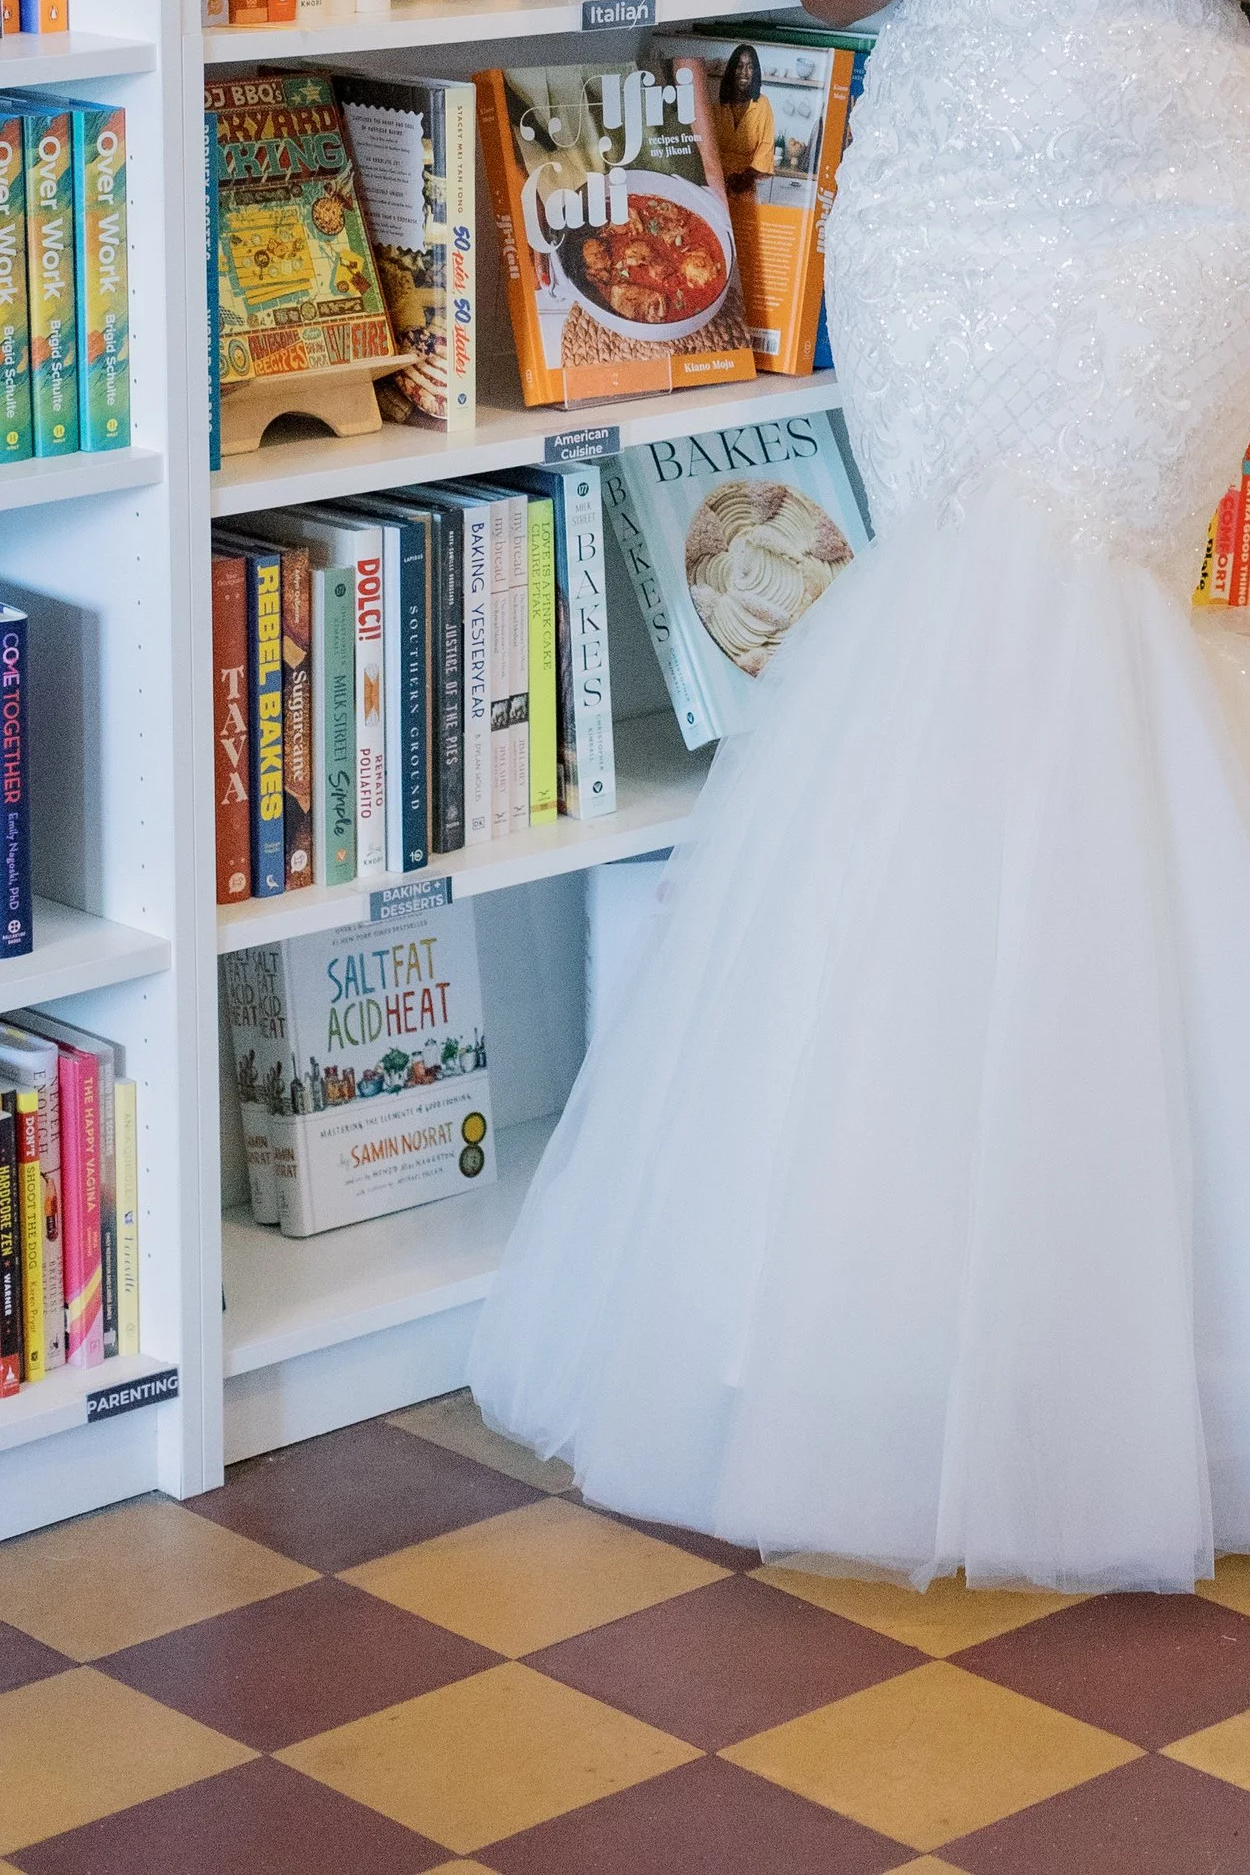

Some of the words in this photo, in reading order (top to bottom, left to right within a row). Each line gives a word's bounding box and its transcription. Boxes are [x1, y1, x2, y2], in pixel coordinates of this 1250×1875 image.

[590, 1, 649, 24] Italian
[648, 135, 680, 146] recipes
[681, 132, 703, 143] from
[650, 147, 664, 158] my
[665, 145, 692, 157] jikoni
[96, 131, 119, 206] Over
[98, 213, 121, 296] Work
[104, 313, 119, 353] Brigid
[106, 355, 119, 406] Schulte
[684, 361, 711, 374] Kiano
[711, 359, 735, 373] Moju
[553, 428, 609, 447] American
[560, 444, 603, 460] Cuisine
[646, 416, 820, 484] BAKES
[470, 522, 485, 594] BAKING
[357, 557, 381, 641] DOLCI!
[256, 564, 283, 686] REBEL
[444, 623, 458, 672] JUSTICE
[409, 605, 421, 715] SOUTHERN
[470, 603, 487, 720] YESTERYEAR
[444, 680, 458, 698] OF
[219, 665, 249, 806] TAVA
[292, 670, 310, 782] Sugarcane
[445, 704, 459, 729] THE
[257, 691, 284, 821] BAKES
[410, 727, 422, 811] GROUND
[445, 736, 459, 766] PIES
[380, 893, 445, 920] DESSERTS
[382, 881, 432, 903] BAKING
[326, 950, 391, 1005] SALT
[391, 937, 439, 988] FAT
[326, 998, 385, 1054] ACID
[384, 982, 452, 1038] HEAT
[83, 1076, 95, 1105] THE
[25, 1116, 37, 1157] DON'T
[84, 1107, 96, 1155] HAPPY
[350, 1135, 400, 1169] SAMIN
[401, 1121, 454, 1155] NOSRAT
[26, 1165, 37, 1207] SHOOT
[85, 1158, 97, 1213] VAGINA
[26, 1211, 38, 1232] THE
[27, 1234, 39, 1272] DOG
[2, 1273, 14, 1316] WARNER
[86, 1375, 179, 1416] PARENTING
